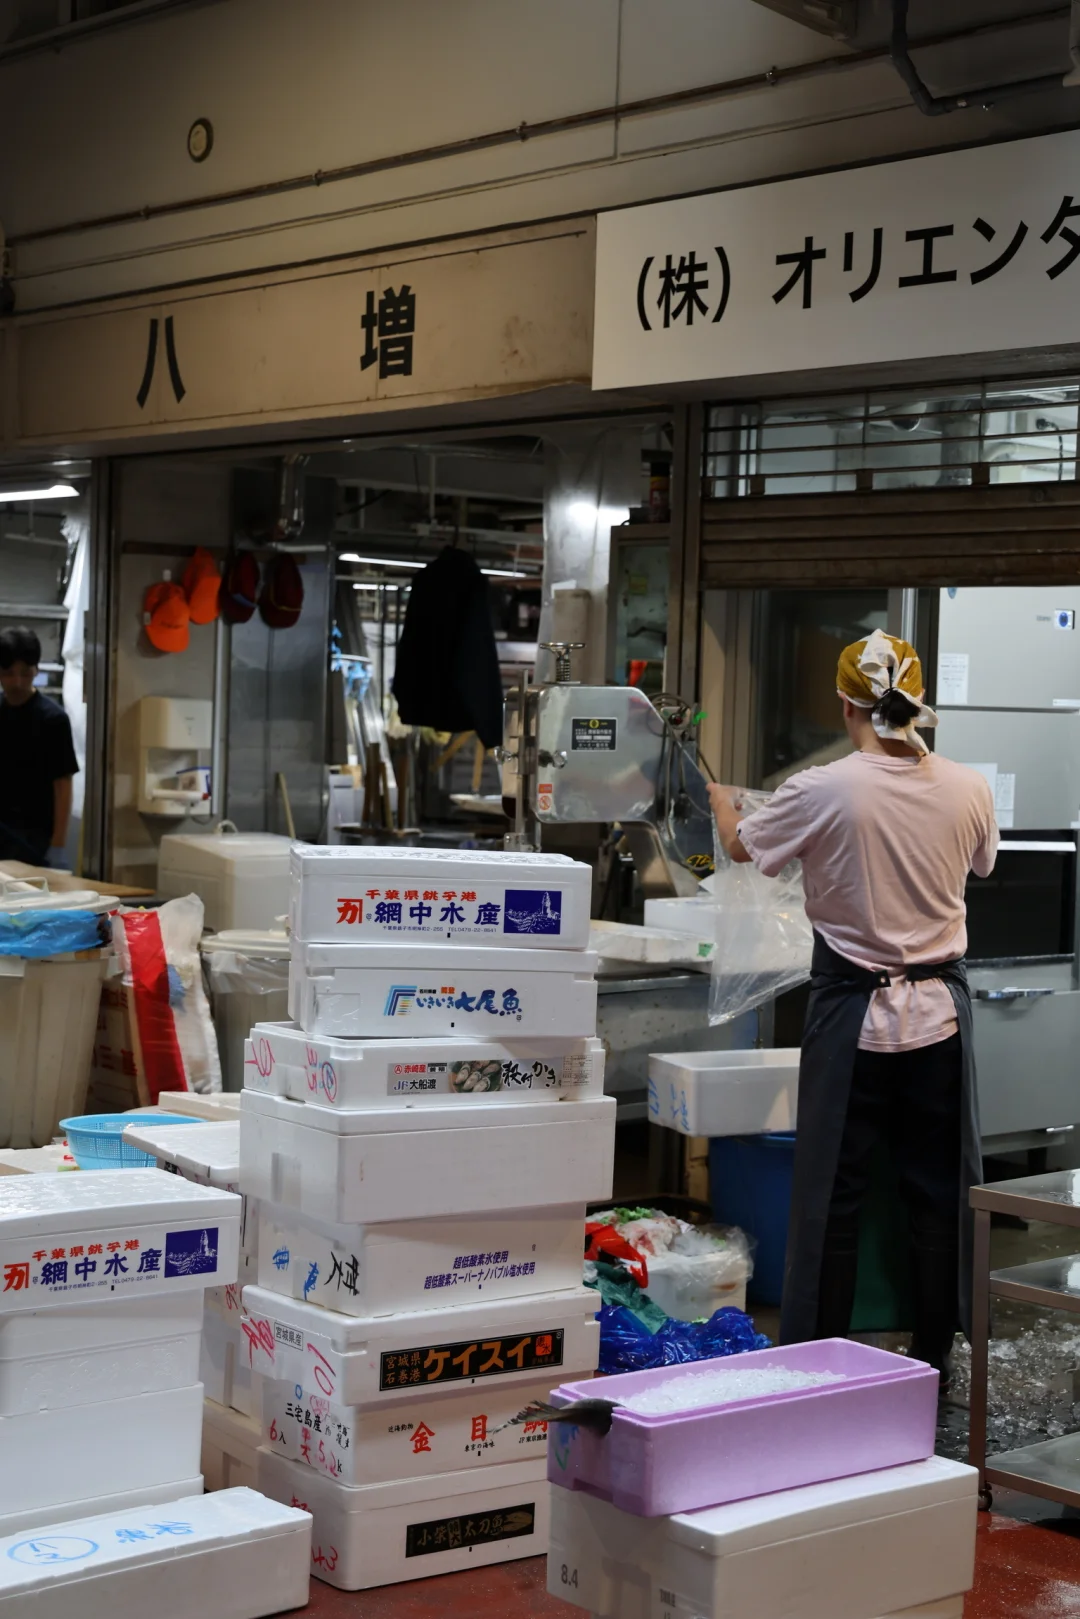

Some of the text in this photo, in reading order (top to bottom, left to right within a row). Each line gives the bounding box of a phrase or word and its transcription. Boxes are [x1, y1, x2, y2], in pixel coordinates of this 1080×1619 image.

[365, 889, 477, 901] 千葉県銚子港
[374, 902, 501, 925] 網中水産
[409, 1078, 437, 1090] 大船渡
[32, 1239, 140, 1262] 千葉県銚子港
[40, 1248, 163, 1286] 網中水産
[275, 1326, 302, 1347] 宮城県産
[385, 1351, 421, 1370] 宮城県
[423, 1337, 531, 1381] ケイスイ
[384, 1367, 421, 1385] 石巻港
[285, 1402, 322, 1433] 三宅島産
[561, 1563, 579, 1588] 8.4
